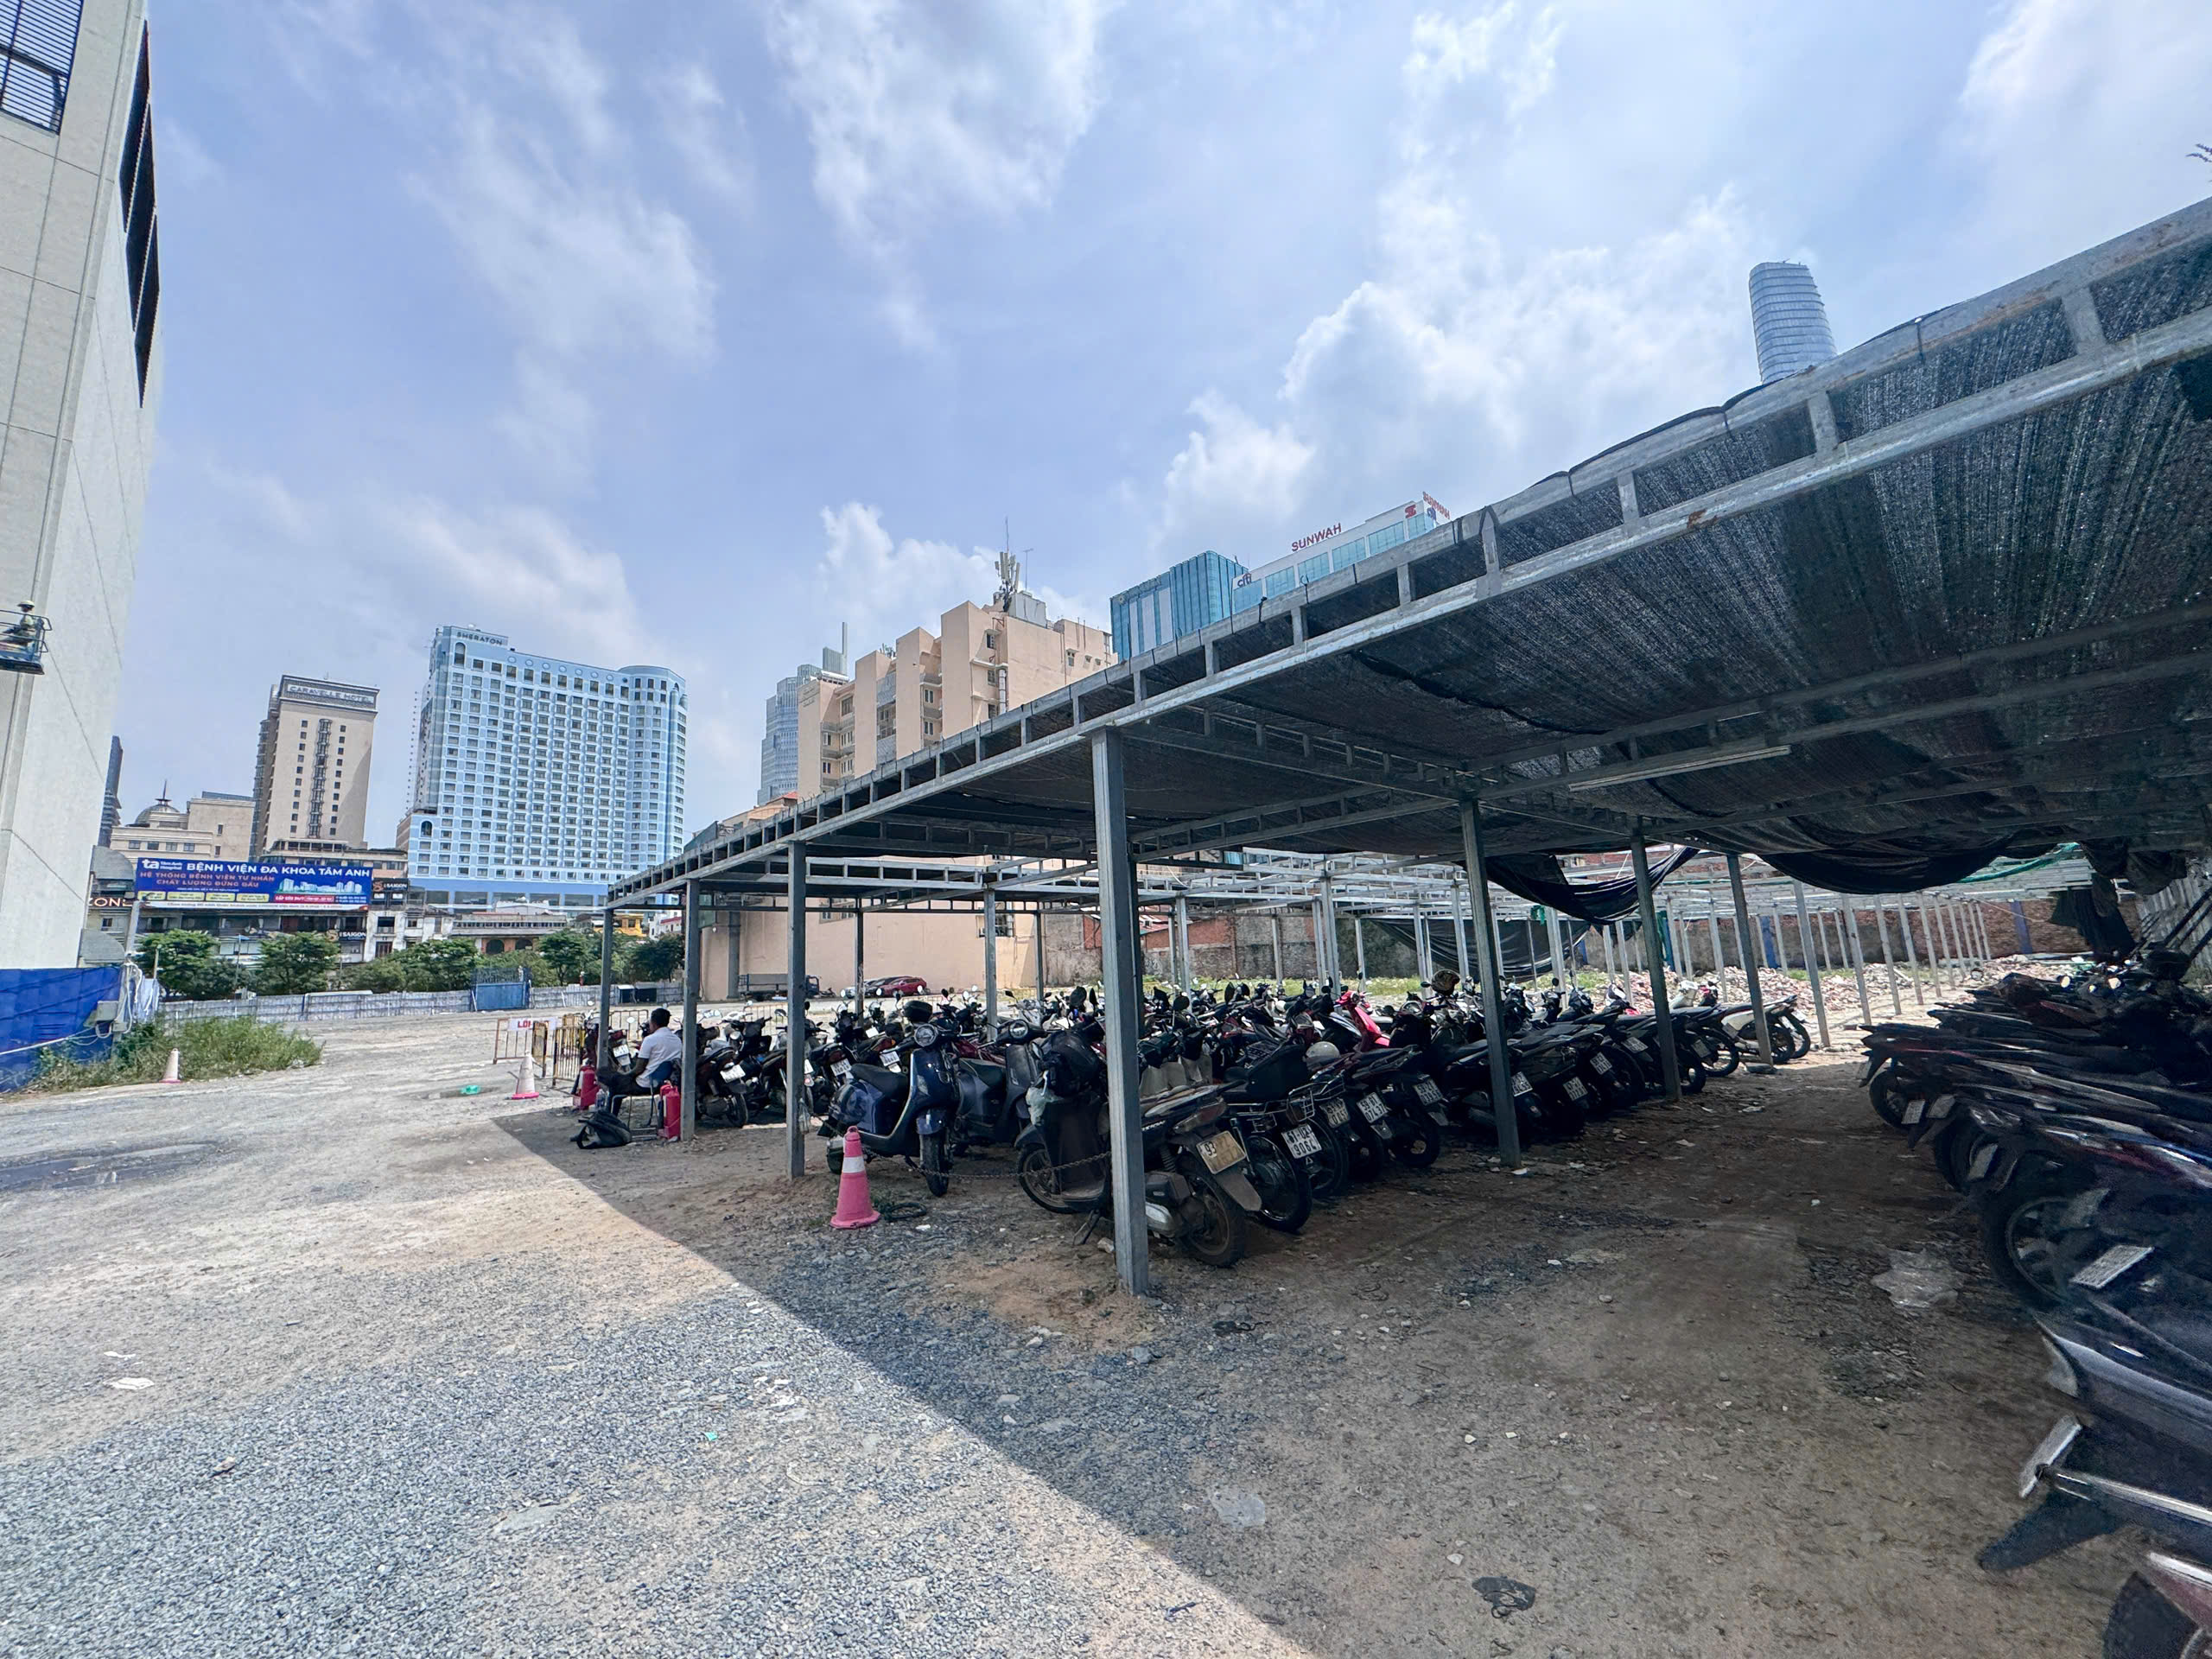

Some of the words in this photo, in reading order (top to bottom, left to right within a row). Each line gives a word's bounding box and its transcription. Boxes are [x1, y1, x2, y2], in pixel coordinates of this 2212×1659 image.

[1291, 522, 1342, 552] SUNWAH
[1237, 572, 1252, 588] citi
[456, 632, 503, 645] SHERATON
[142, 859, 160, 869] ta
[187, 861, 223, 873] BỆNH
[226, 863, 257, 874] VIỆN
[281, 867, 316, 875] KHOA
[318, 867, 342, 876] TÂM
[1293, 1139, 1318, 1156] 9064
